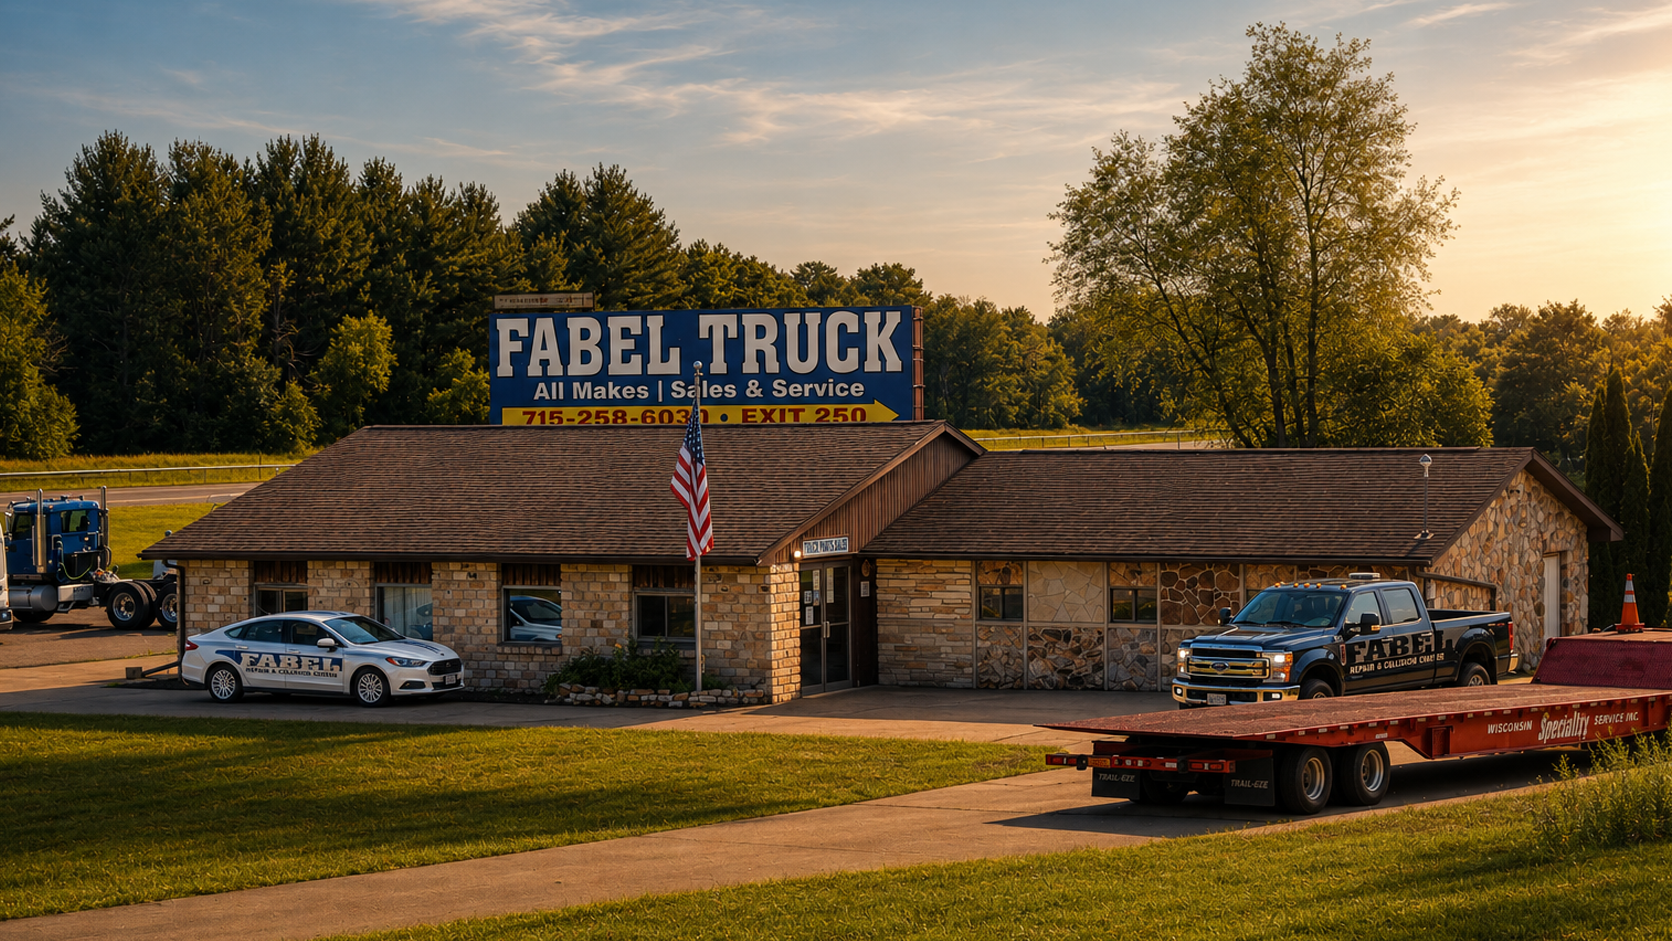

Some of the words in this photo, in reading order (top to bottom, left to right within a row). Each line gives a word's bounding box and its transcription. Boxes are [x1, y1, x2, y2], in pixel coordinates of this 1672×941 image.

[496, 315, 681, 377] FABEL
[699, 311, 902, 374] TRUCK
[533, 382, 564, 400] All
[572, 382, 649, 399] Makes
[671, 380, 737, 398] Sales
[745, 379, 763, 397] &
[772, 379, 865, 397] Service
[742, 408, 805, 423] EXIT
[815, 407, 867, 423] 250
[1347, 630, 1453, 663] FABEL
[240, 653, 340, 671] FABEL
[1487, 720, 1533, 734] WISCONSIN
[1594, 713, 1623, 725] SERVICE
[1230, 779, 1269, 790] TRAIL-EZE
